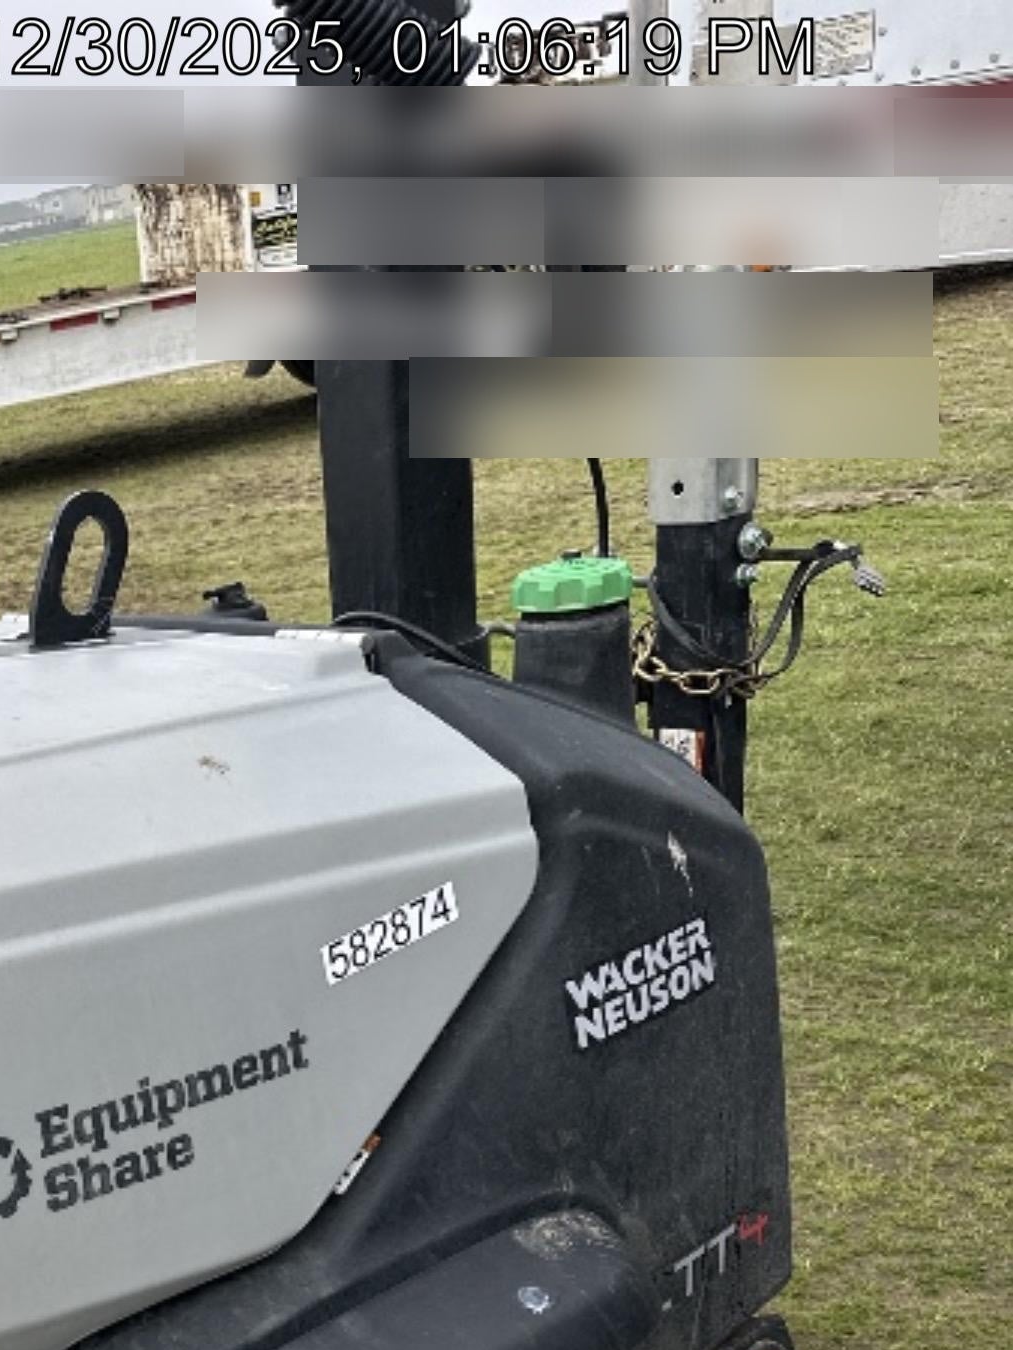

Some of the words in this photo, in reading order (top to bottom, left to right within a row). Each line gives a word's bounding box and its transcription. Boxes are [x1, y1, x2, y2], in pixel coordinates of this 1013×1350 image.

[327, 886, 452, 980] 582874
[565, 917, 712, 1009] WACKER
[573, 950, 718, 1049] NEUSON
[34, 1028, 309, 1159] Equipment
[43, 1132, 196, 1213] Share
[673, 1212, 770, 1298] TT4
